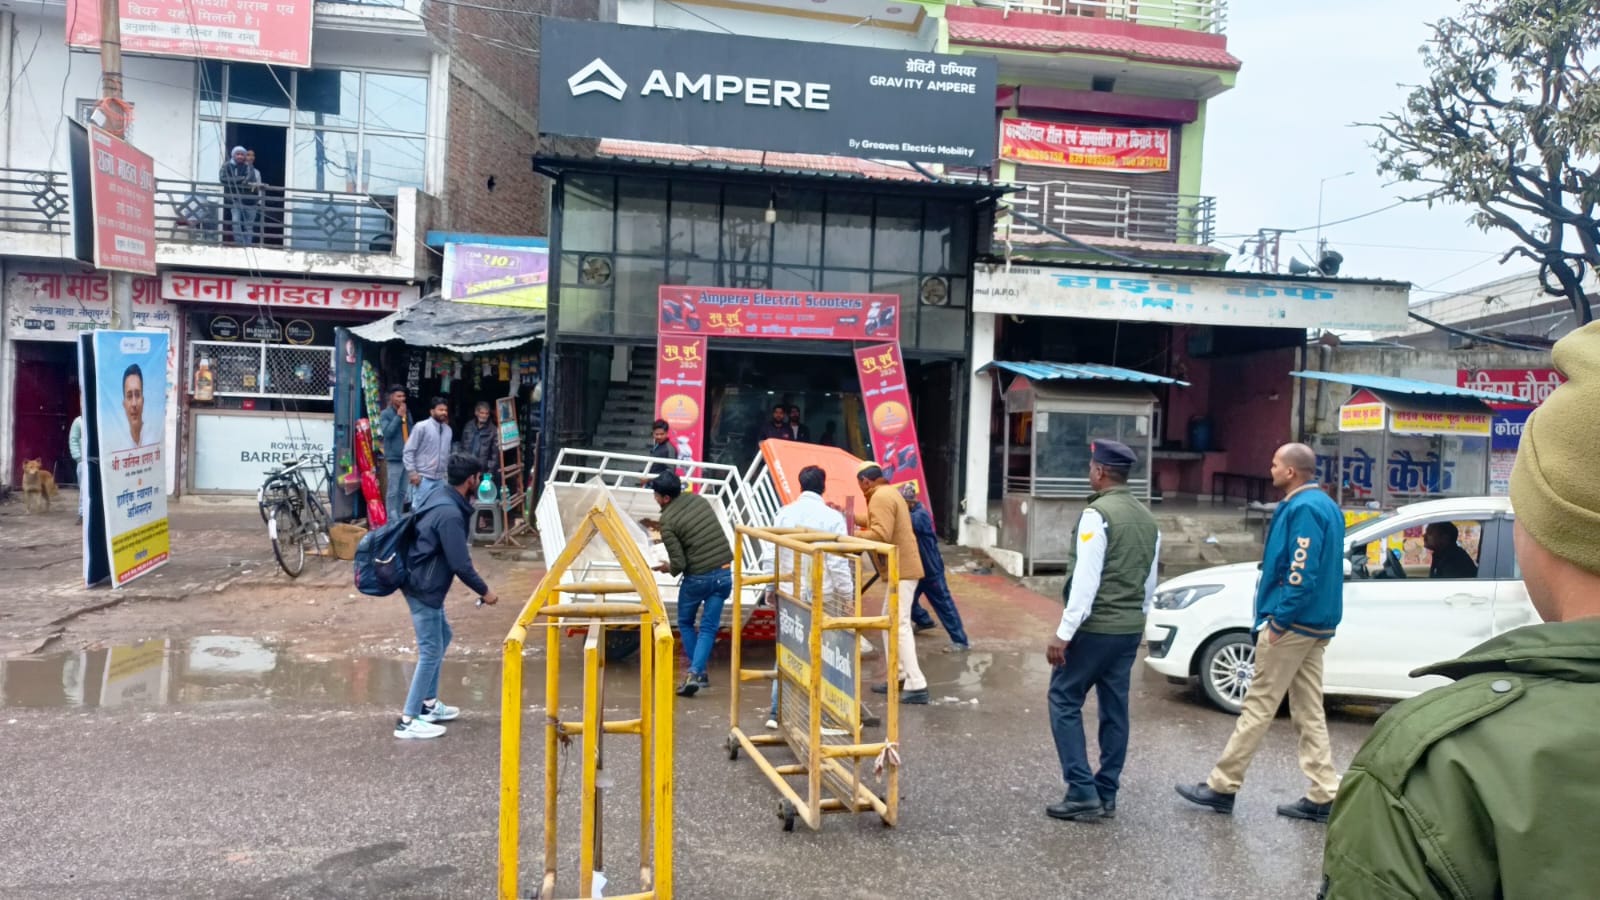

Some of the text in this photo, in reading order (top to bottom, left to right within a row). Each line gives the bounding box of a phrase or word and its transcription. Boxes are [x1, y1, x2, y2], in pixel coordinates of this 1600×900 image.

[905, 58, 977, 79] ग्रेविटी एम्पियर
[641, 67, 831, 111] AMPERE
[869, 74, 976, 94] GRAVITY AMPERE
[848, 138, 975, 159] By Greaves Electric Mobility
[172, 274, 402, 309] राना मॉडल शॉप
[699, 291, 863, 310] Ampere Electric Scooters
[271, 441, 324, 451] ROYAL STAG
